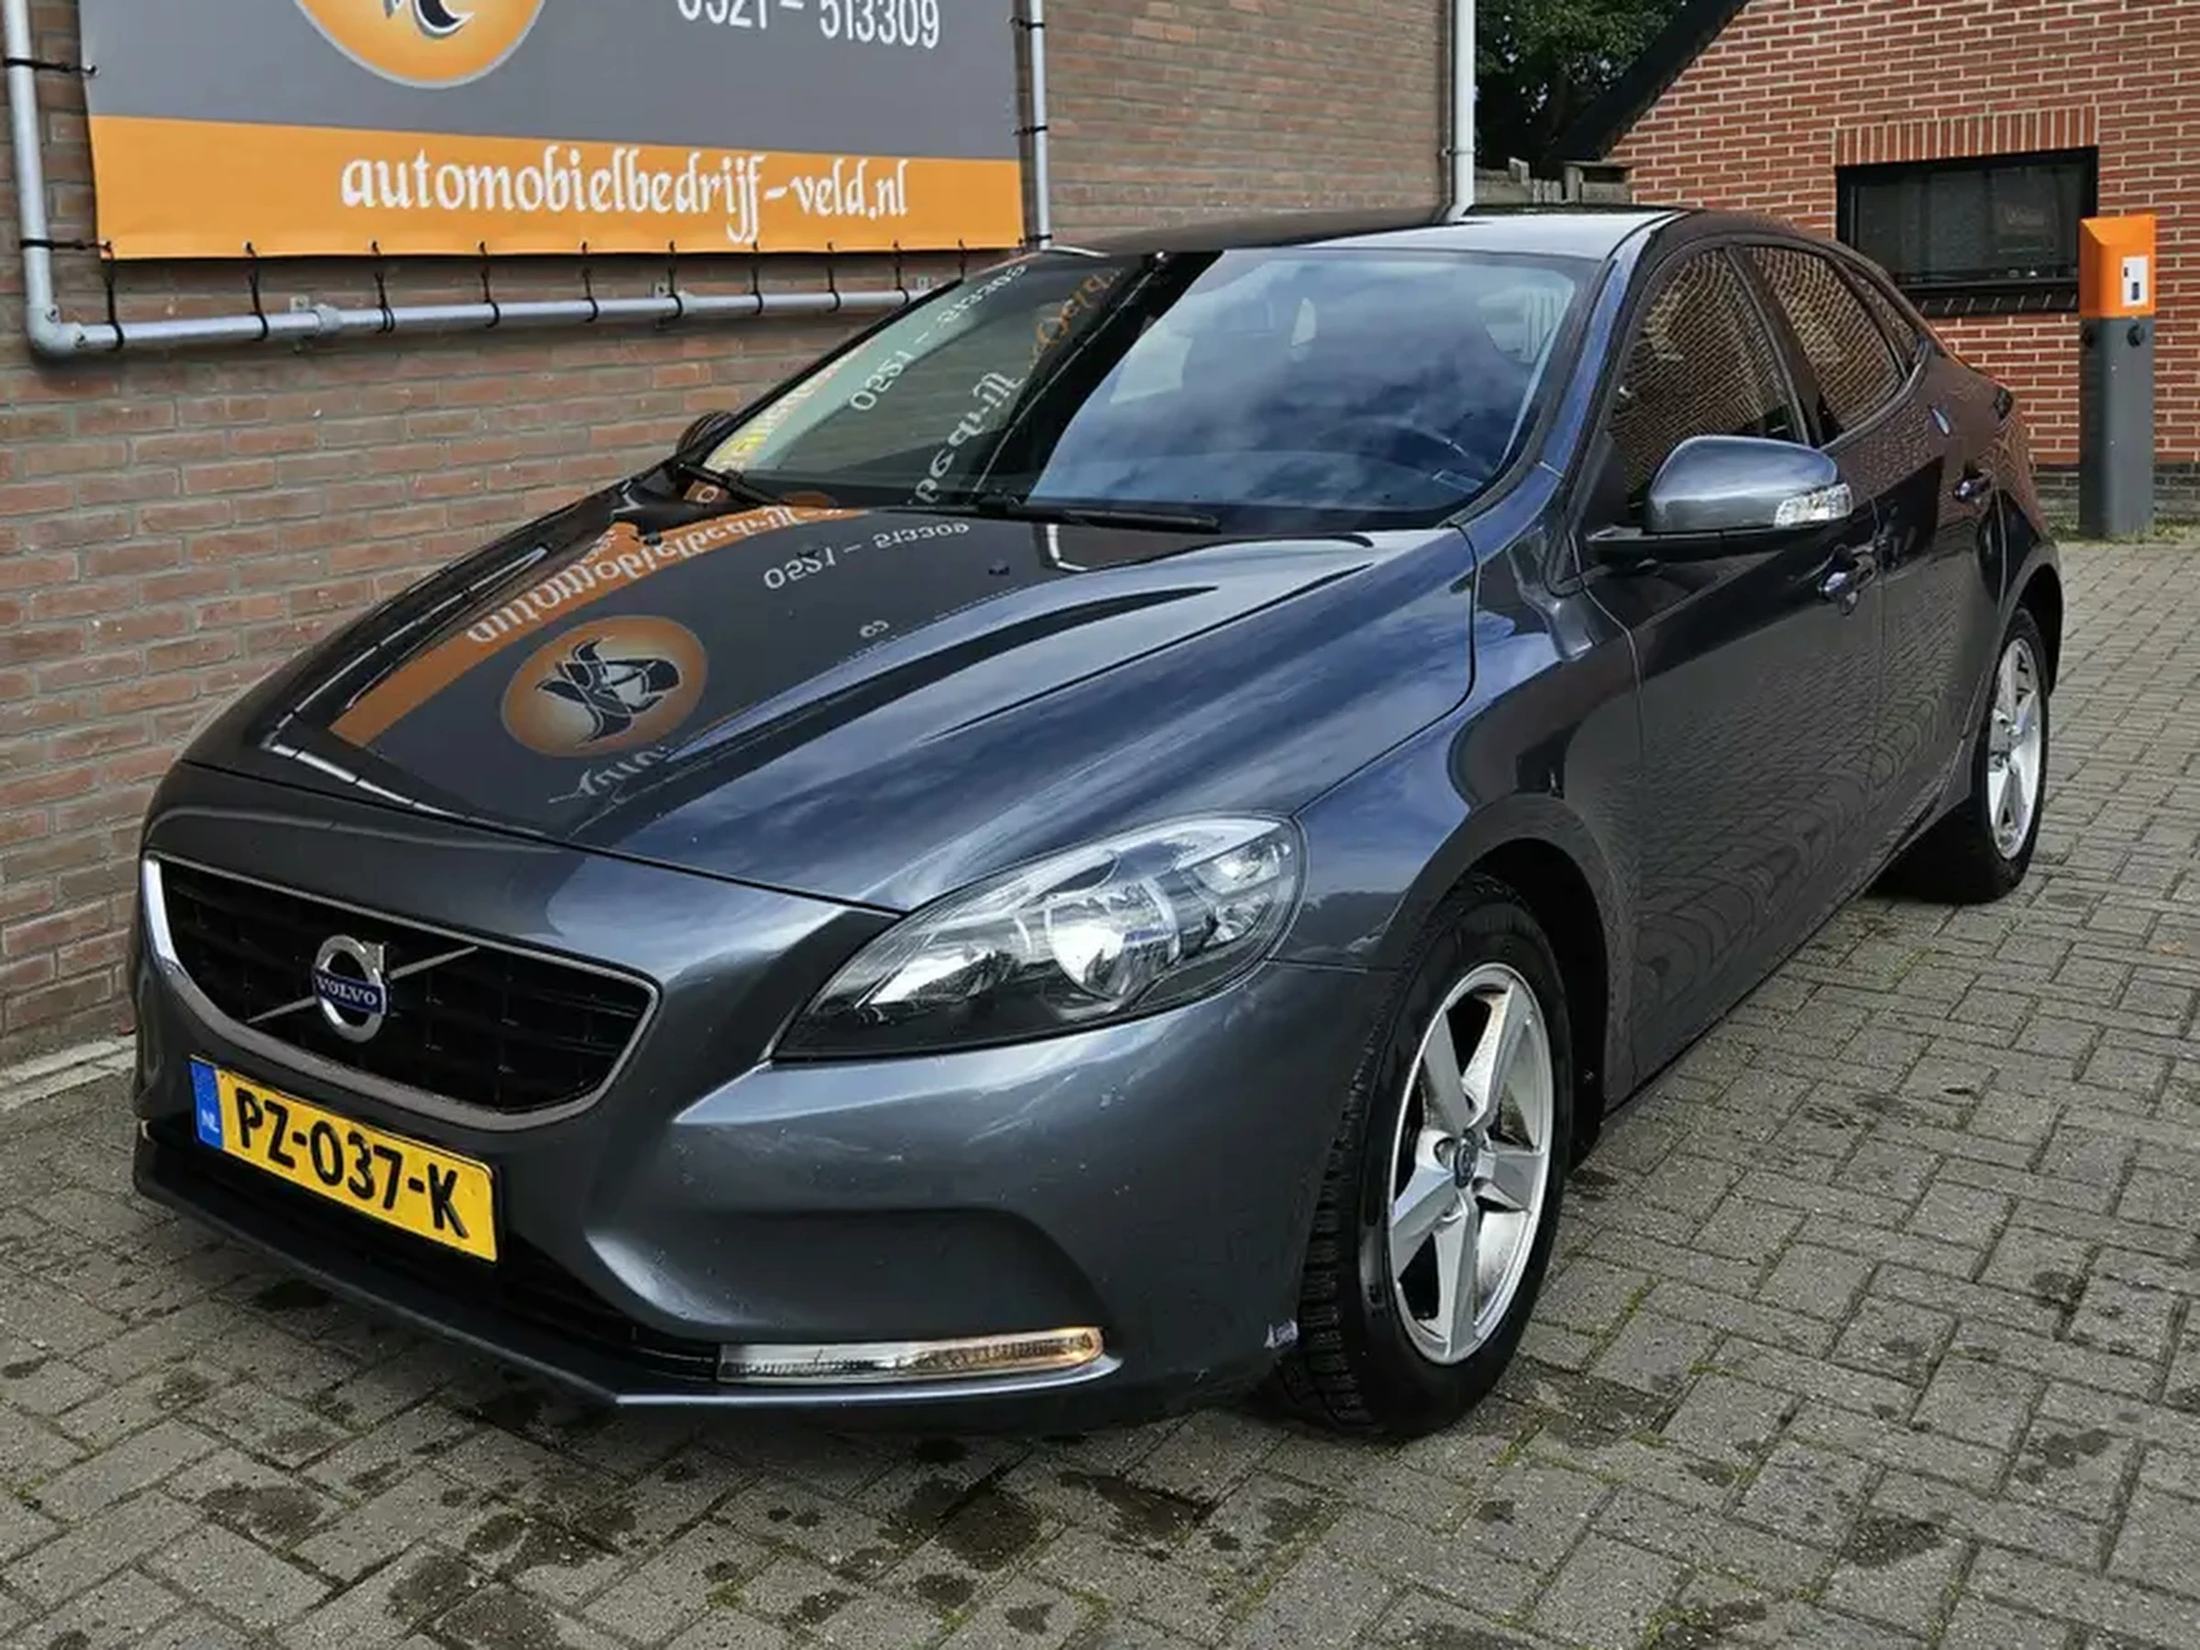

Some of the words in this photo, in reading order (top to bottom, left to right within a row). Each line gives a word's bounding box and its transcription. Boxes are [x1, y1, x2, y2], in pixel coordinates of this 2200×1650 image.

[820, 0, 940, 49] 513309
[341, 145, 909, 244] automobielbedrijf-veld.nl
[316, 975, 378, 1006] VOLVO
[201, 1108, 220, 1133] NL
[236, 1087, 469, 1239] PZ-037-K
